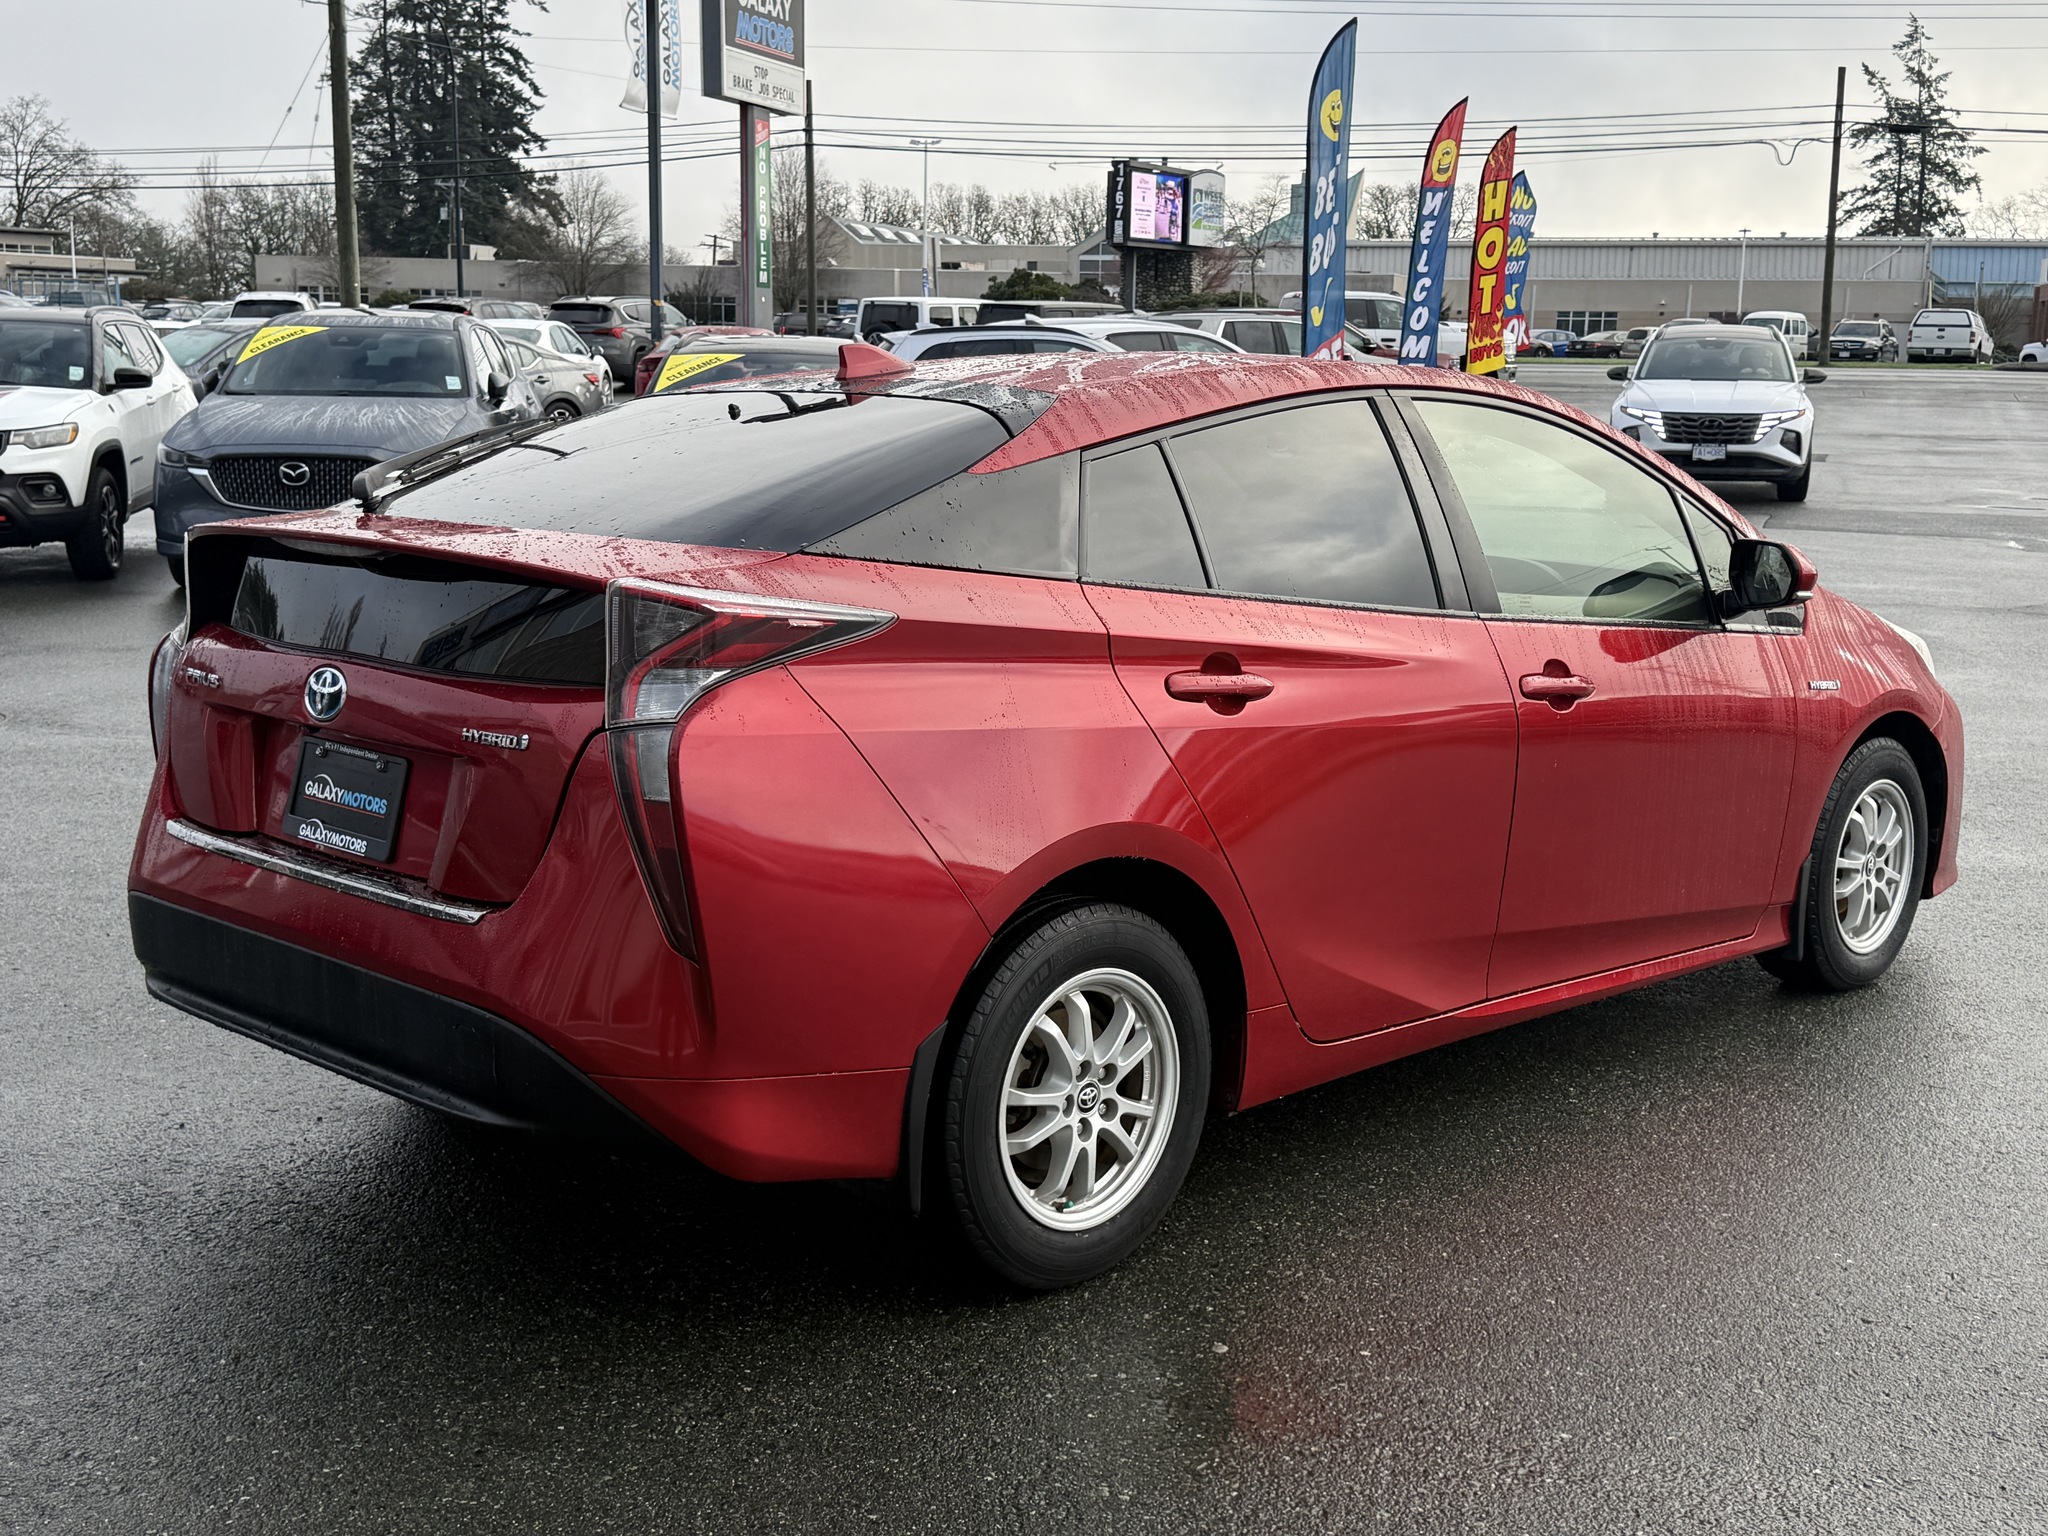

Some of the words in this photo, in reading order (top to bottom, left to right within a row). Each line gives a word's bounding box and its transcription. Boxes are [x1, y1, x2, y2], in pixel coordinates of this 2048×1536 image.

[738, 0, 791, 21] LAXY
[736, 10, 794, 53] MOTORS
[754, 66, 769, 80] STOP
[733, 75, 753, 92] BRAKE
[759, 82, 769, 96] JOB
[773, 86, 795, 103] SPECIAL
[759, 147, 767, 174] NO
[1115, 163, 1124, 219] 1767
[759, 186, 768, 283] PROBLEM
[1477, 180, 1509, 316] HOT
[1401, 191, 1448, 367] WELCOM
[249, 329, 306, 353] CLEARANCE
[1470, 340, 1503, 363] BUYS
[666, 356, 724, 381] CLEARANCE
[186, 667, 219, 688] PRIUS
[1810, 680, 1837, 690] HYBRID
[461, 728, 518, 748] HYBRID
[340, 744, 364, 756] Independent
[365, 750, 379, 759] Dealer
